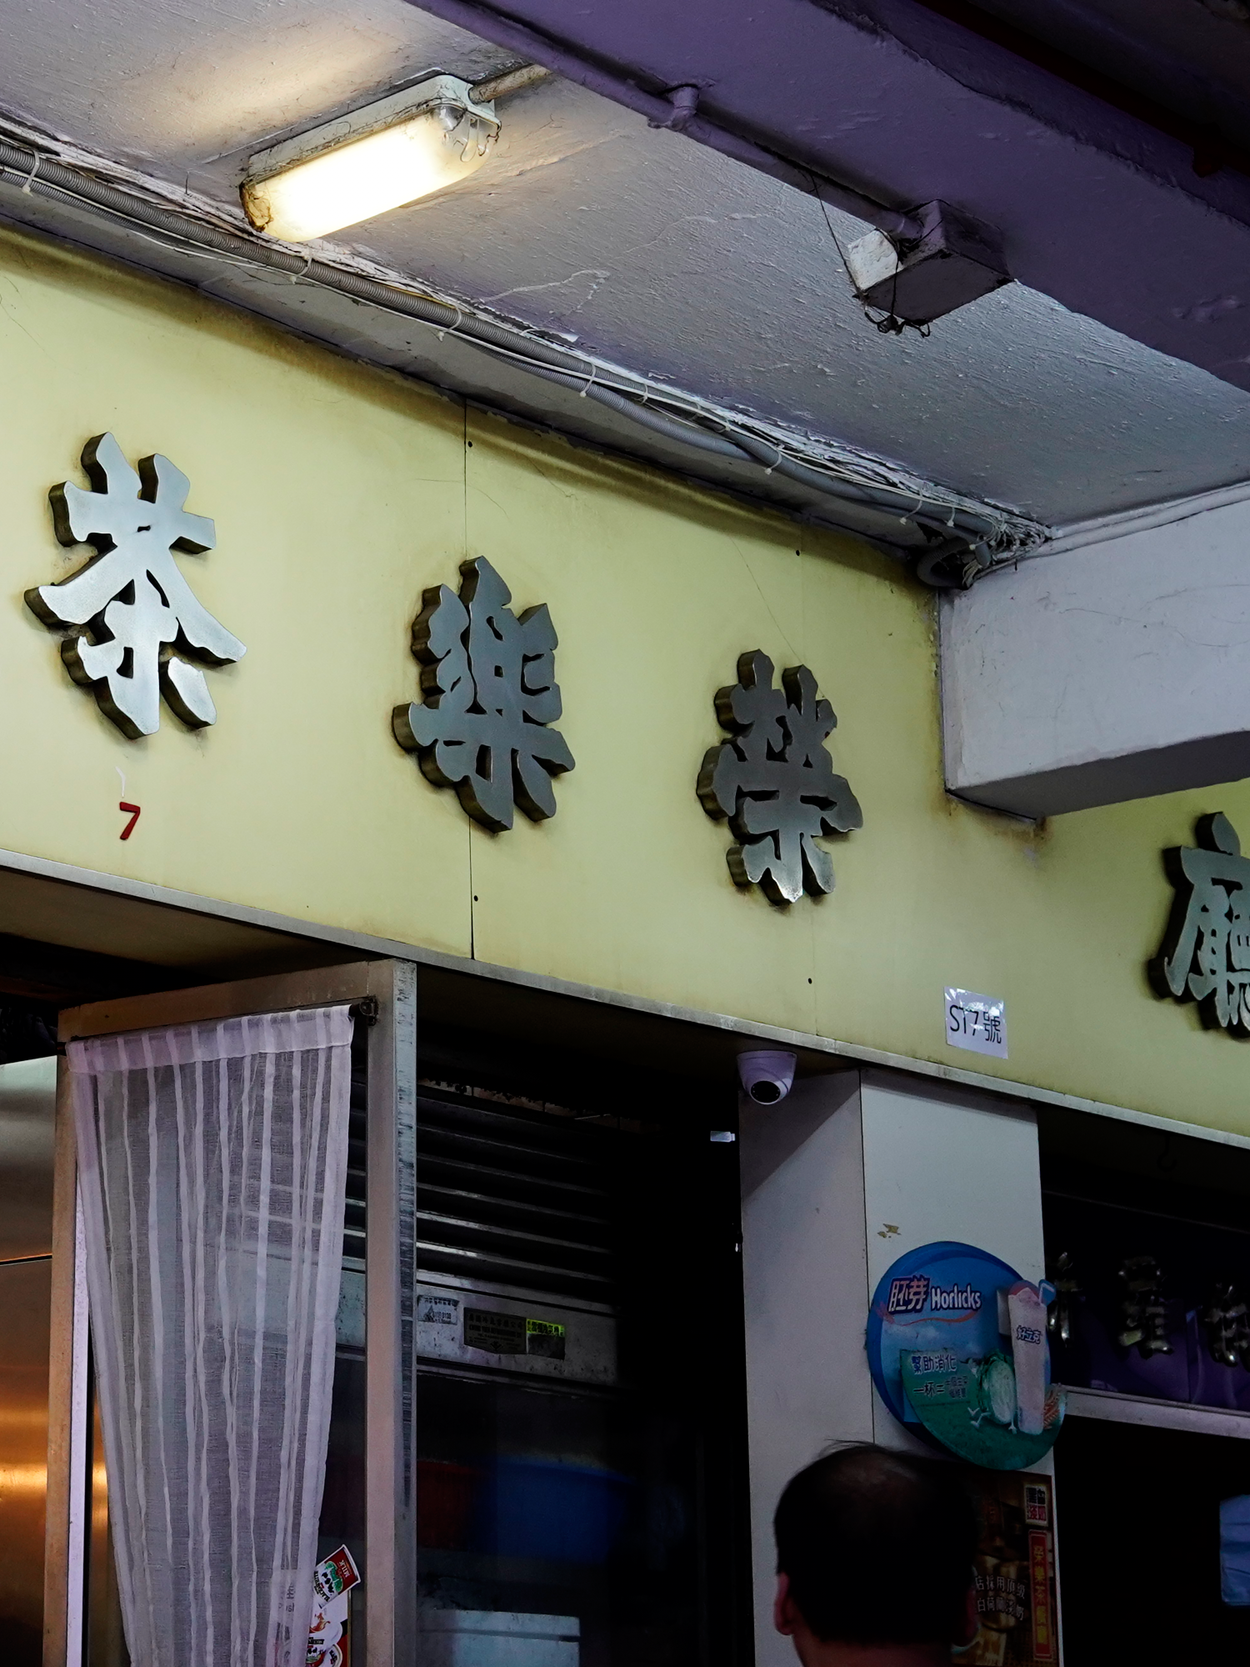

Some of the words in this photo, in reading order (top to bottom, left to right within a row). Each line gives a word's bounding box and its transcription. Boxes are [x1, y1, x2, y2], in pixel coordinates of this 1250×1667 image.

[119, 801, 141, 841] 7
[888, 1275, 930, 1313] 胚芽
[931, 1283, 982, 1311] Horlicks
[1016, 1325, 1042, 1345] 好立克
